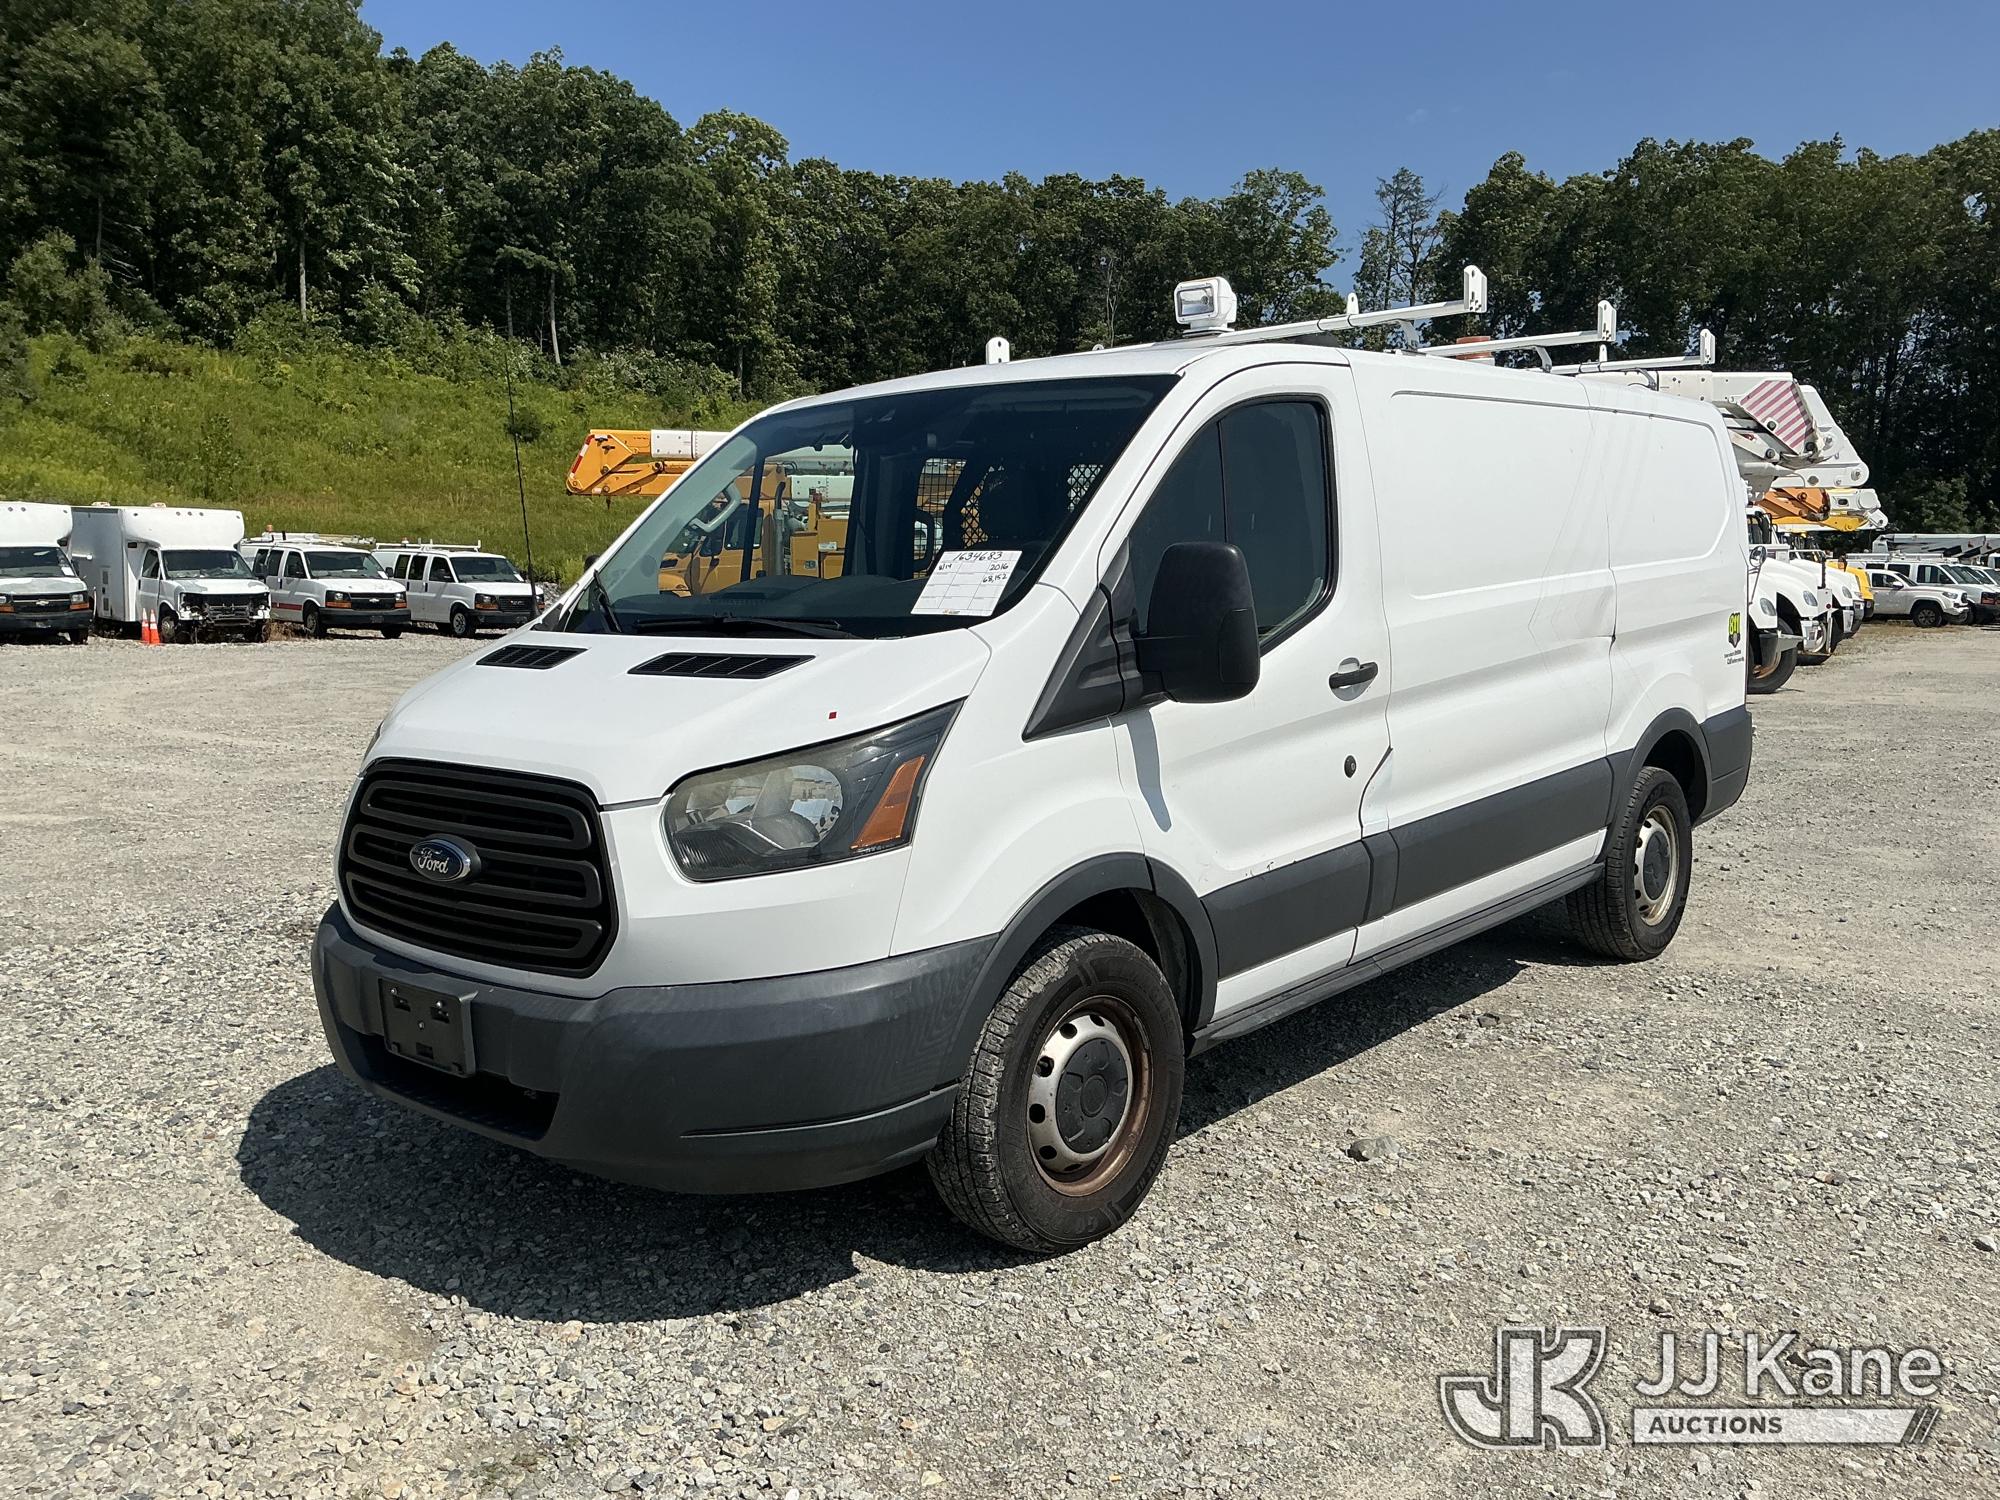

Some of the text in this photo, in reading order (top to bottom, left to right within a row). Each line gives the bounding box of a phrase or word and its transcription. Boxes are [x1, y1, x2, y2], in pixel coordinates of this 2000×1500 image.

[953, 552, 1002, 561] 1634683
[1729, 612, 1740, 635] 811
[417, 847, 450, 874] Ford
